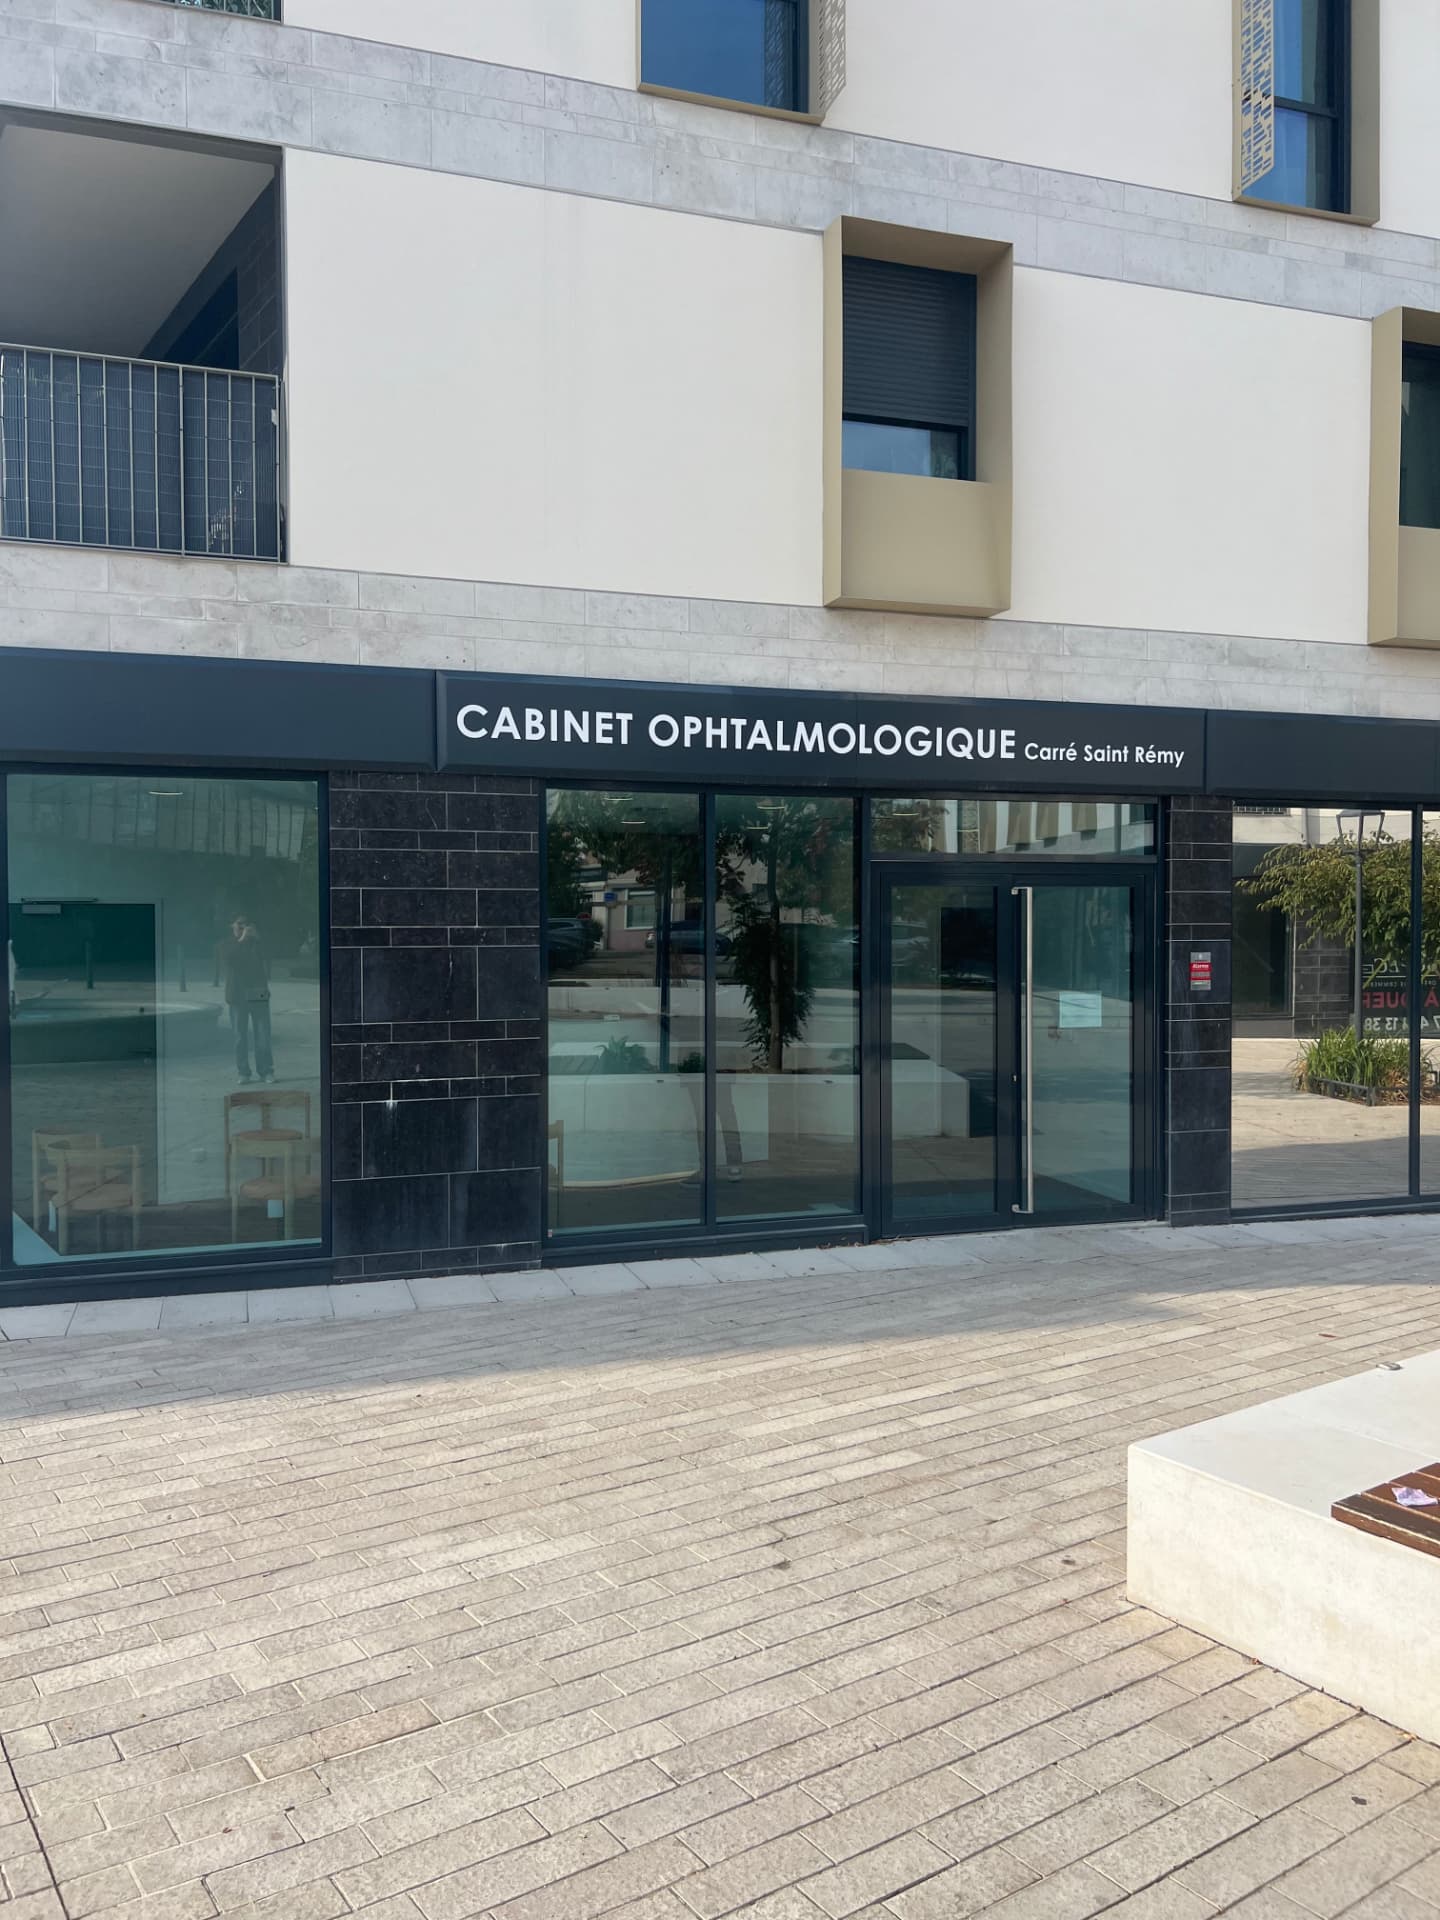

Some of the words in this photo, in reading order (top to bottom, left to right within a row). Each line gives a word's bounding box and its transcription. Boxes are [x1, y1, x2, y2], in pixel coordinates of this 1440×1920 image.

[456, 704, 633, 745] CABINET
[648, 713, 1017, 760] OPHTALMOLOGIQUE
[1024, 742, 1078, 762] Carré
[1083, 744, 1129, 763] Saint
[1135, 744, 1185, 768] Rémy
